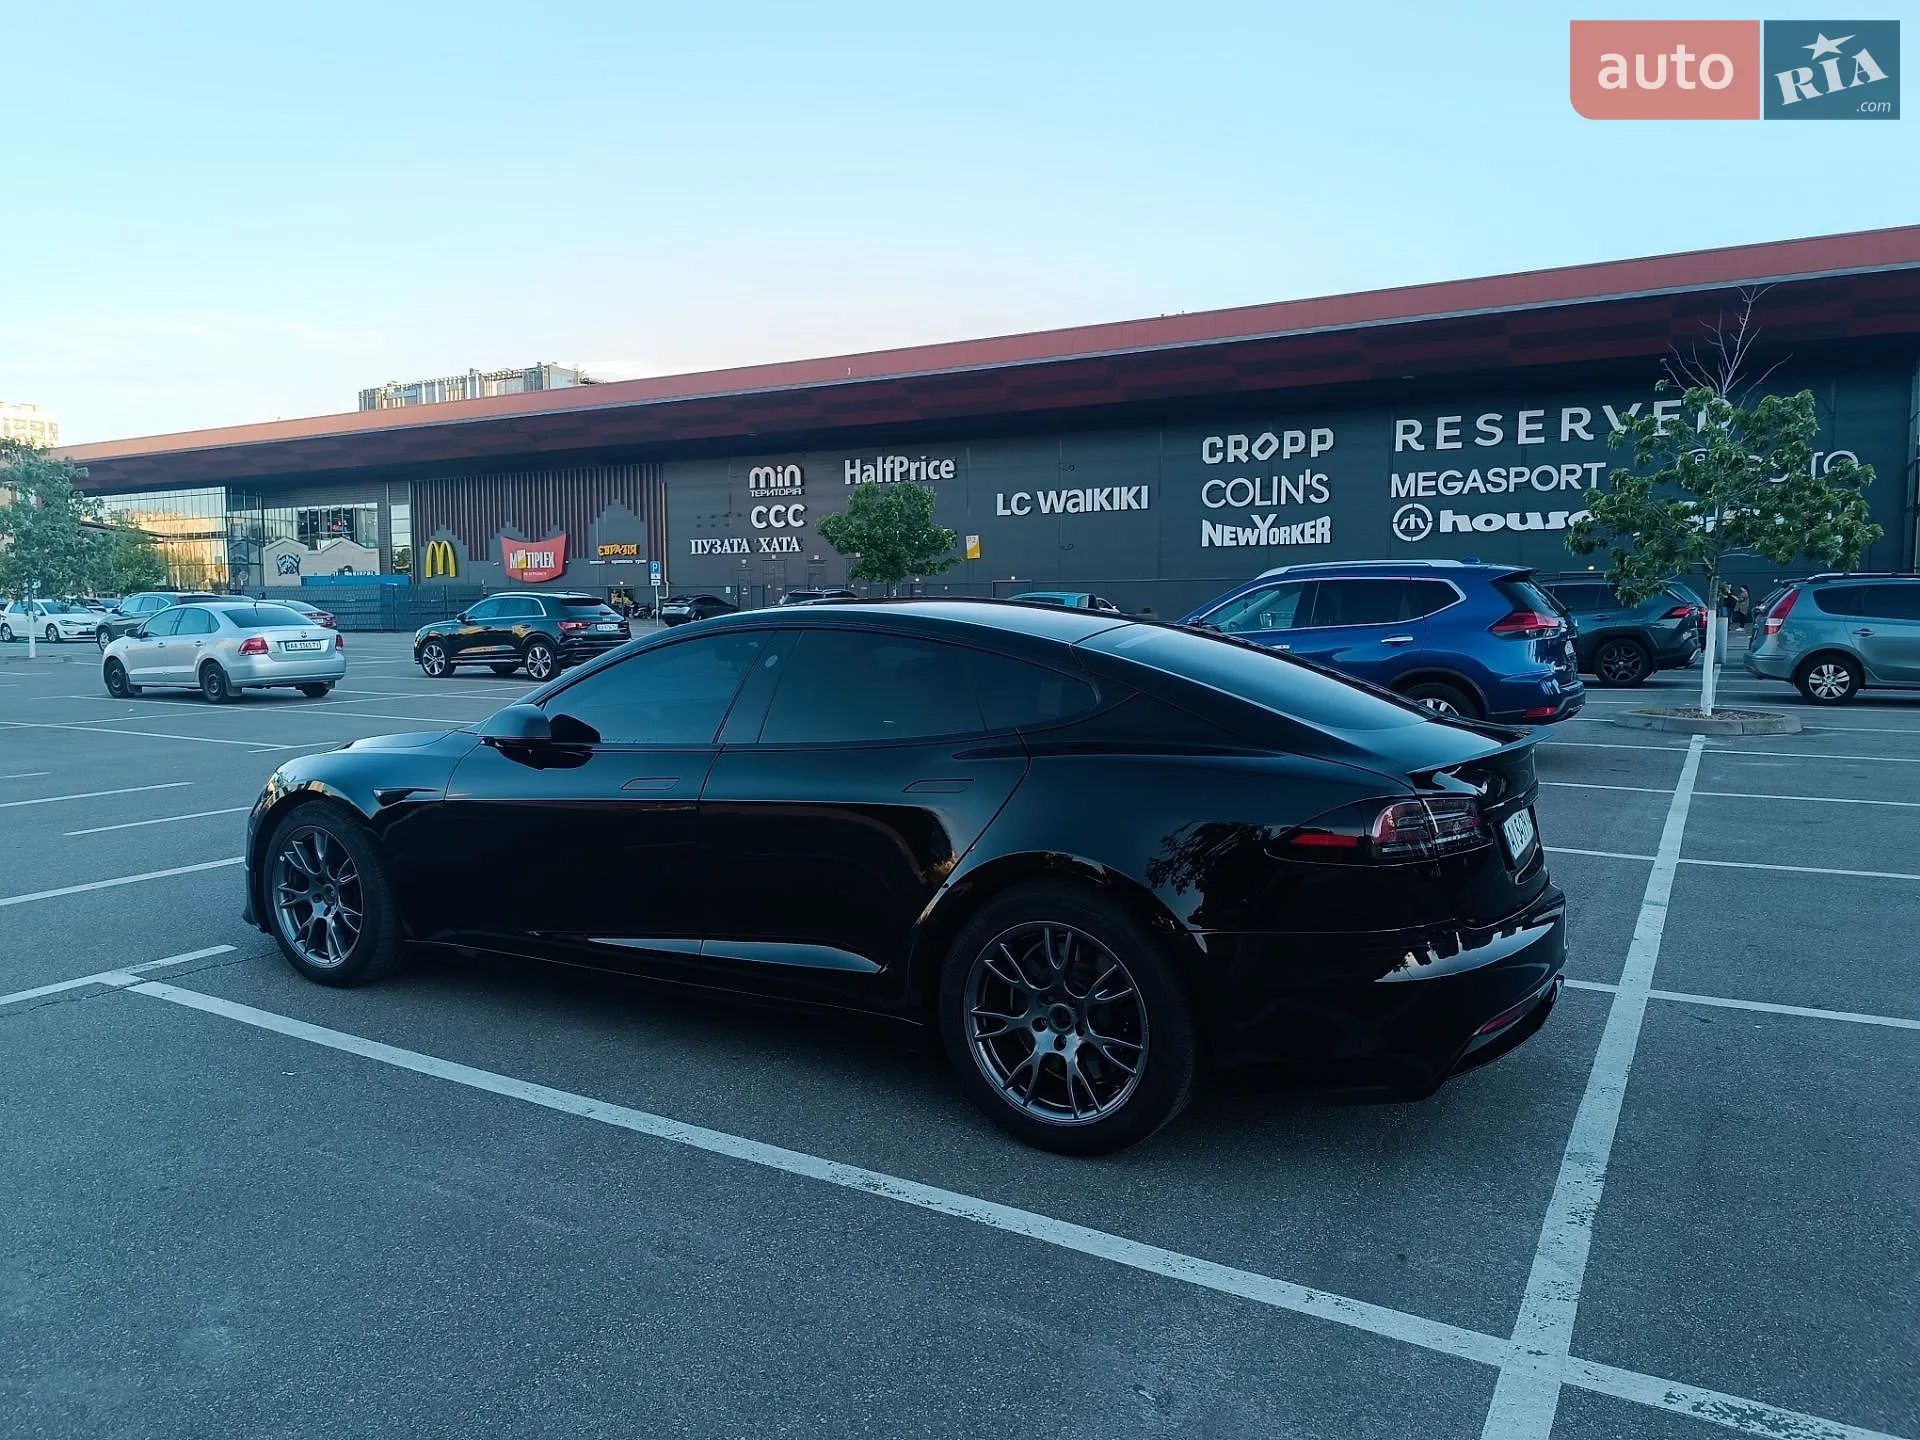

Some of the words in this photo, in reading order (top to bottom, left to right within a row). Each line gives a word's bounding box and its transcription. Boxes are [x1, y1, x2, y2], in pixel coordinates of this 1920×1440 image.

[1202, 427, 1334, 465] CROPP
[844, 455, 956, 485] HalfPrice
[1390, 461, 1607, 499] MEGASPORT
[1201, 468, 1330, 509] COLIN'S
[750, 503, 806, 529] CCC
[996, 491, 1032, 517] LC
[509, 550, 556, 569] MTIPLEX
[689, 537, 751, 555] ПУЗАТА
[758, 536, 802, 554] ХАТА
